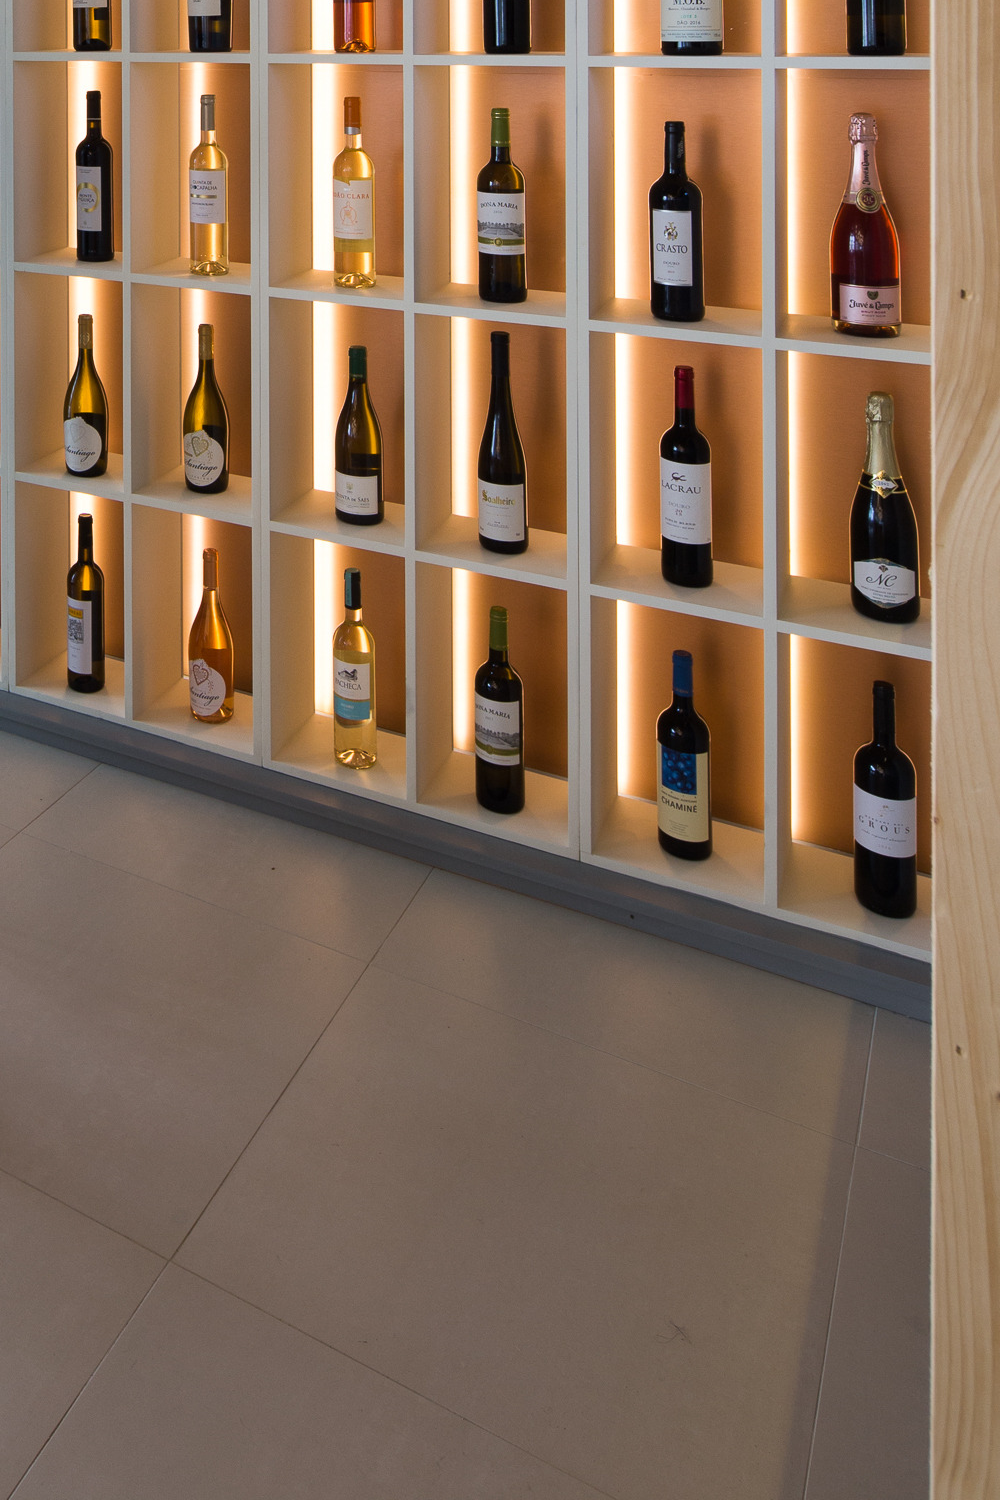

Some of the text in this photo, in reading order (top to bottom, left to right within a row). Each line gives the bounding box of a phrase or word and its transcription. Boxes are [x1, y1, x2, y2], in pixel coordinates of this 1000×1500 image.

[346, 192, 370, 200] CLARA
[497, 201, 519, 210] MARIA
[656, 242, 688, 254] CRASTO
[849, 299, 869, 309] Juvé
[874, 301, 895, 312] Camps
[66, 445, 96, 463] Santiago
[186, 458, 218, 478] Santiago
[661, 480, 702, 495] LACRAU
[482, 489, 516, 506] Soalheiro
[865, 574, 898, 588] NC
[191, 686, 220, 706] Santiago
[488, 708, 511, 719] MARIA
[661, 795, 698, 813] CHAMINÉ
[858, 814, 910, 835] GROUS
